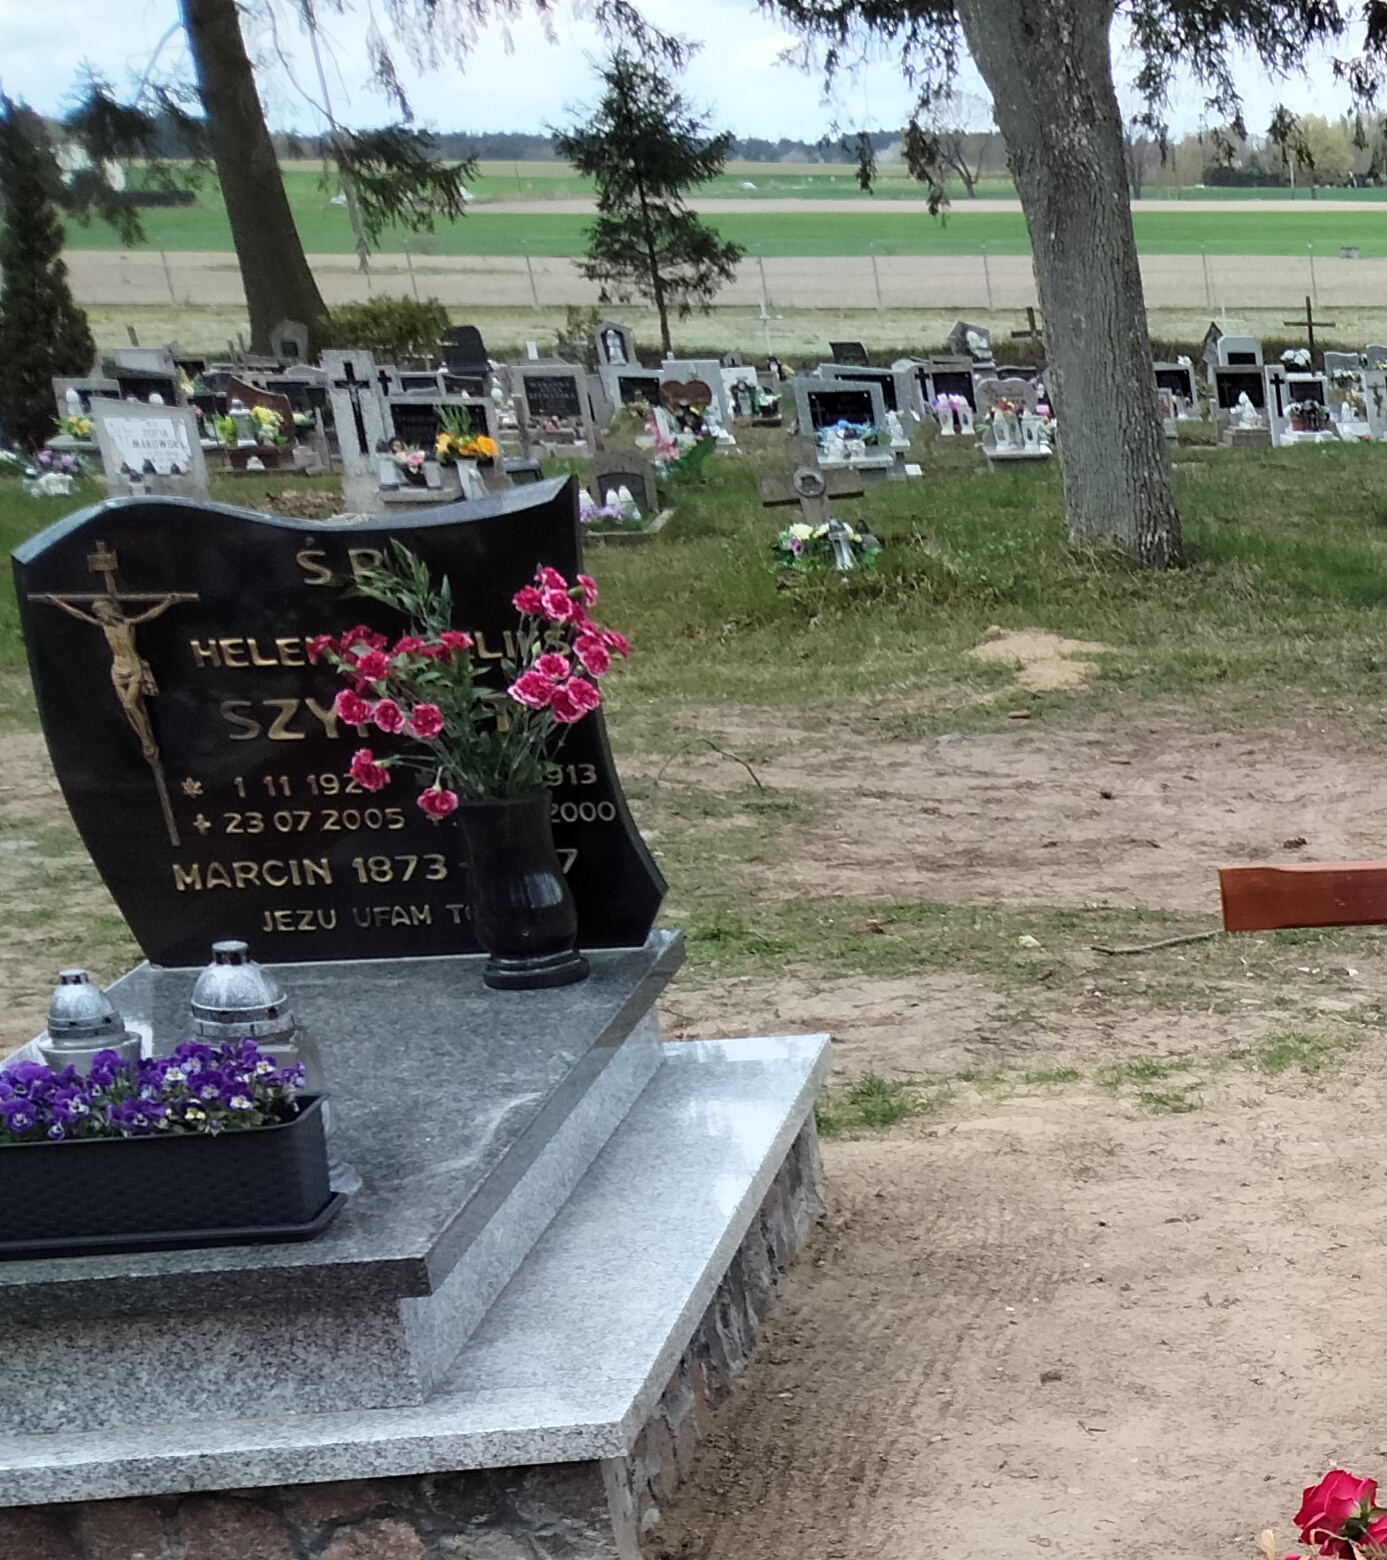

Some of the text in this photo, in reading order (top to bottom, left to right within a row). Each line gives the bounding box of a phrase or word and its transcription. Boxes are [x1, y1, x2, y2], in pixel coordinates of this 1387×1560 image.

[172, 853, 448, 891] MARCIN 1873
[263, 908, 337, 932] JEZU
[352, 903, 432, 928] UFAM
